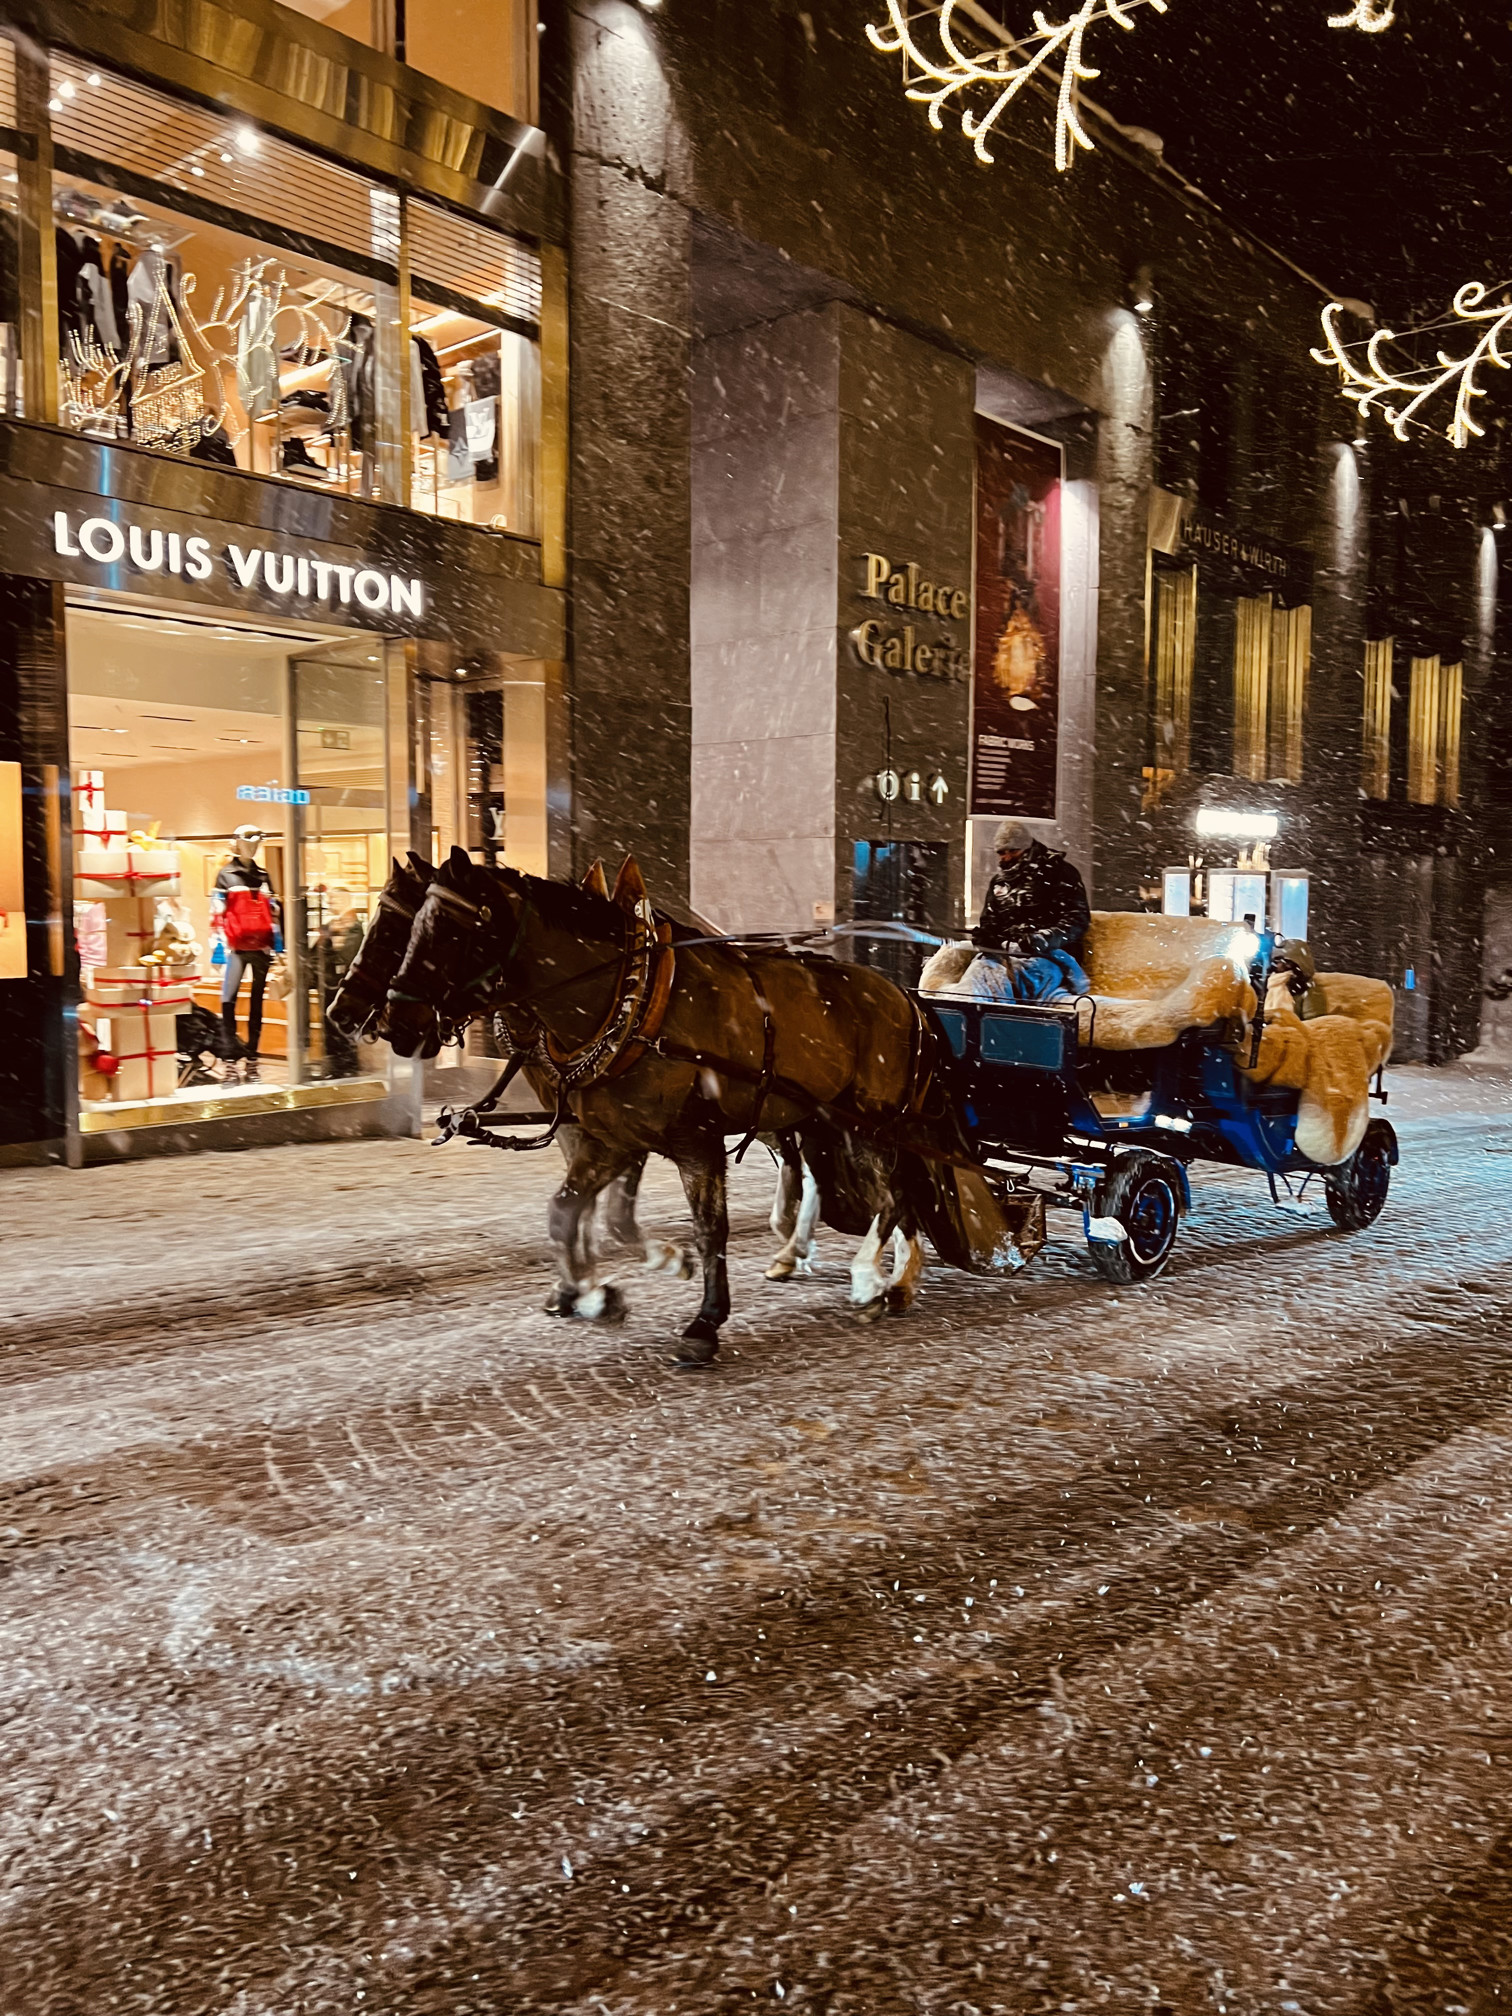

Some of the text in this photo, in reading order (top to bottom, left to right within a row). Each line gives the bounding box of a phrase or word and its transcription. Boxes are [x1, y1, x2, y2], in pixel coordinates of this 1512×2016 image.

[54, 511, 422, 616] LOUIS VUITTON
[1184, 517, 1238, 560] HAUSER
[862, 552, 967, 619] Palace
[856, 619, 970, 682] Galerie
